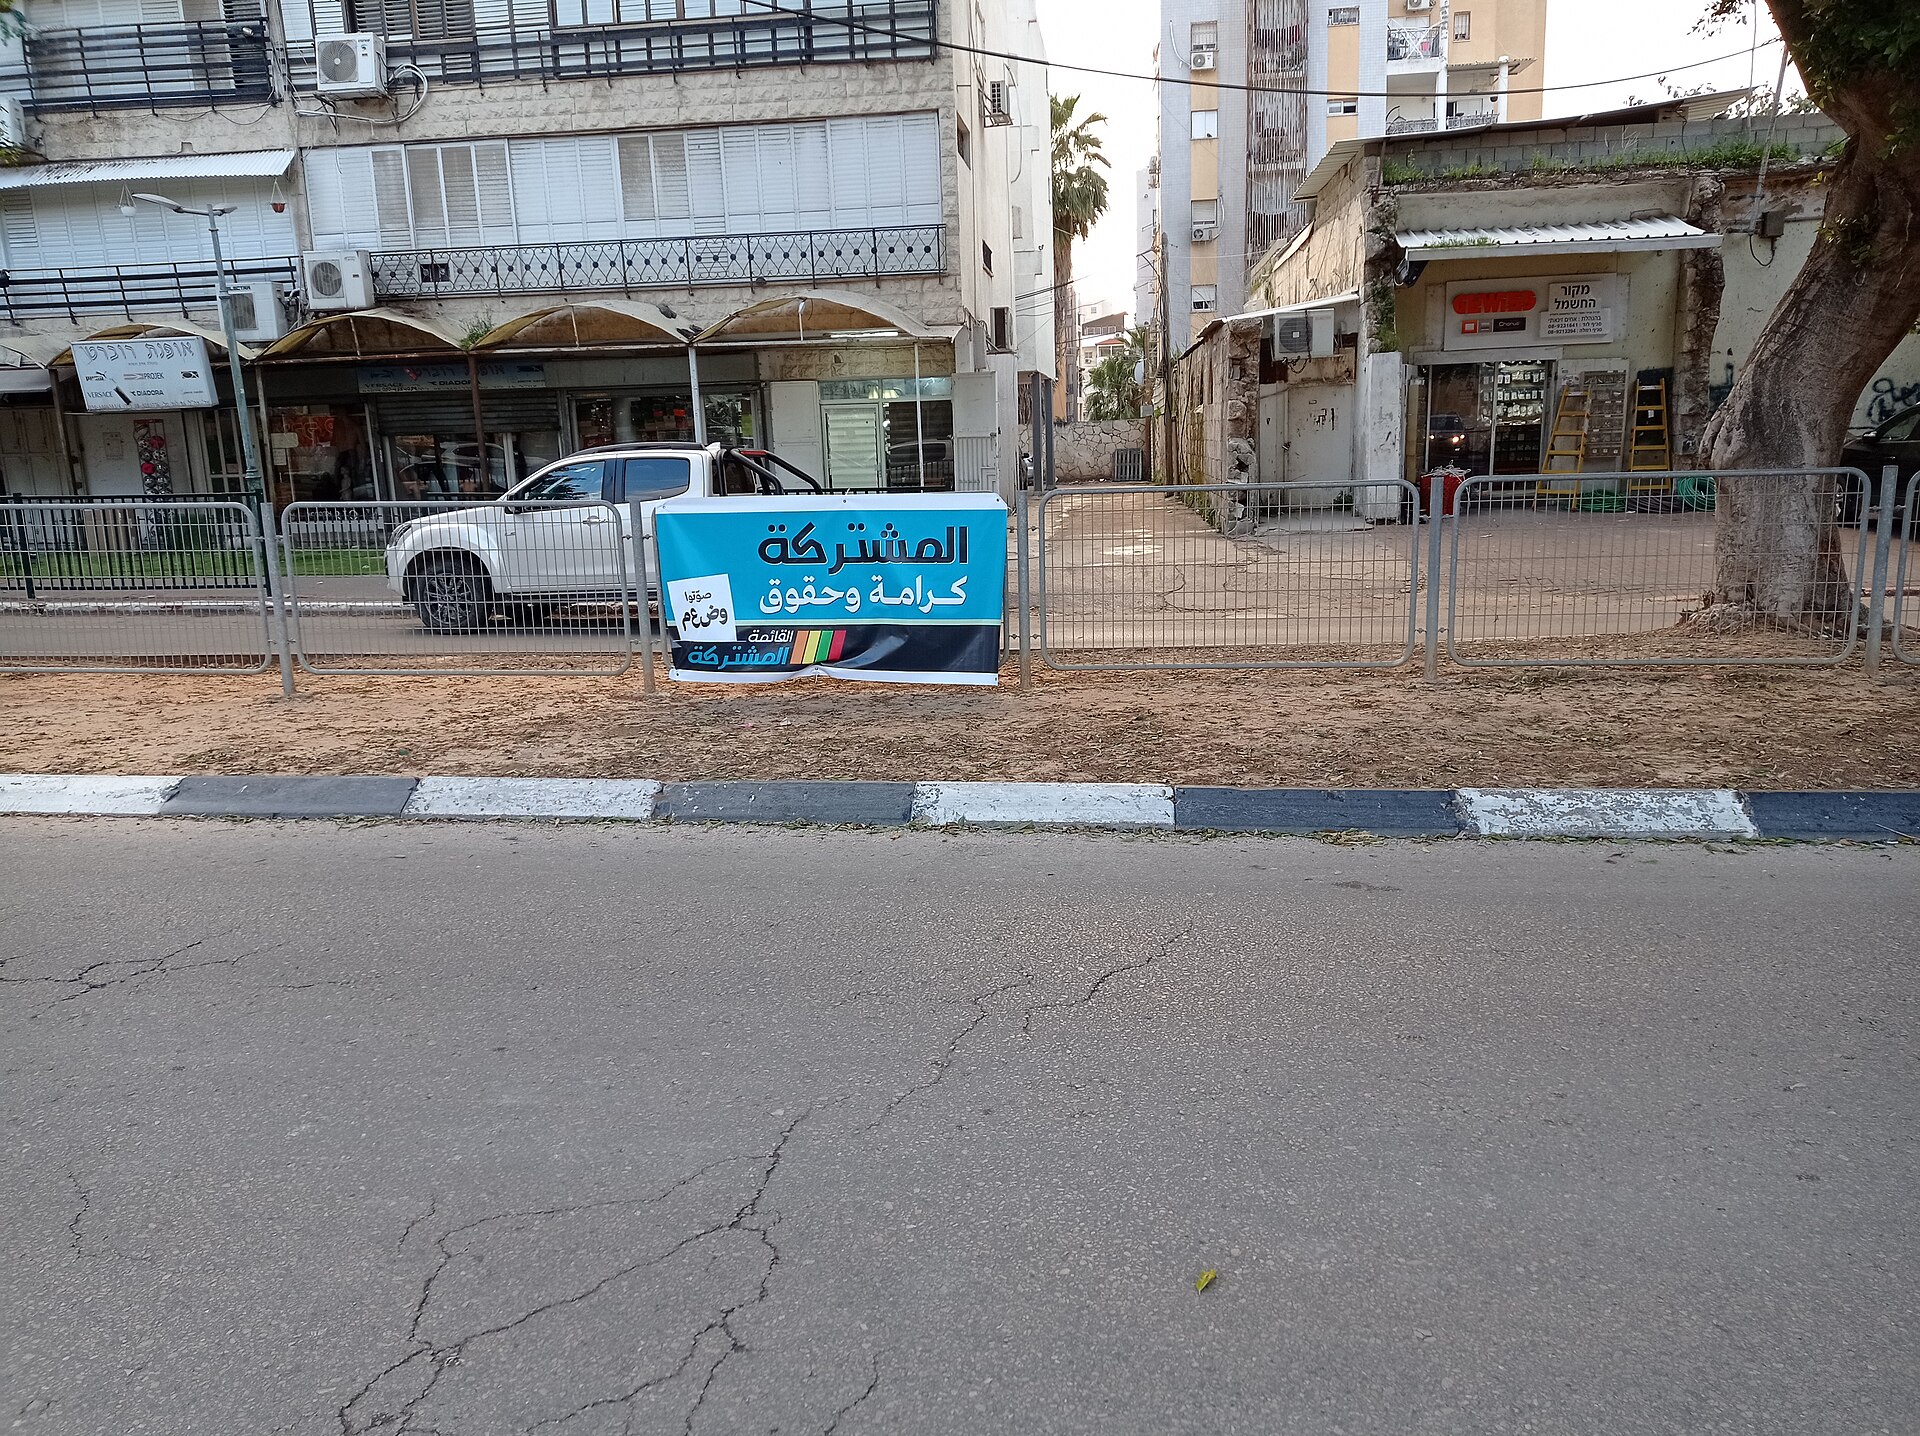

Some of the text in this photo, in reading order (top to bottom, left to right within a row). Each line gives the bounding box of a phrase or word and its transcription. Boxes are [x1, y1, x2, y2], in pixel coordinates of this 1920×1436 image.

[1561, 284, 1590, 298] מקור
[1554, 298, 1596, 310] החשמל
[79, 341, 194, 361] אופנת רוברט
[87, 391, 113, 399] VERSACE
[758, 522, 969, 575] المشتركة
[759, 574, 968, 614] كرامة وحقوق
[747, 630, 795, 643] القائمة
[687, 644, 790, 670] المشتركة
